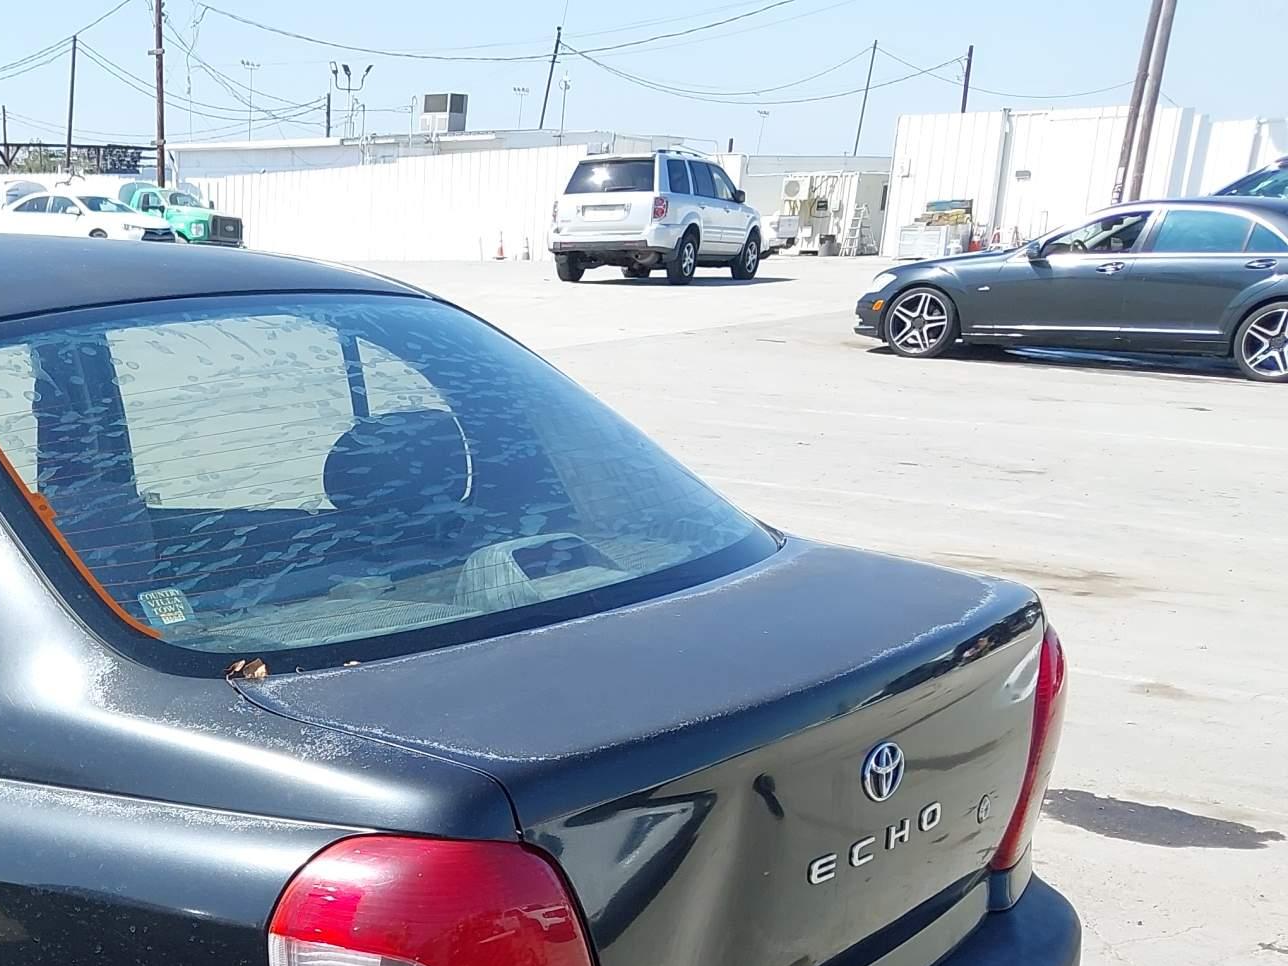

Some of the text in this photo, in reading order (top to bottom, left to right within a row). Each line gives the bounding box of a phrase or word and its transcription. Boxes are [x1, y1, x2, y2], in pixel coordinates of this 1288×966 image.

[139, 589, 180, 601] COUNTRY
[147, 597, 183, 608] VILLA
[153, 603, 185, 616] TOWN
[808, 800, 942, 885] ECHO
